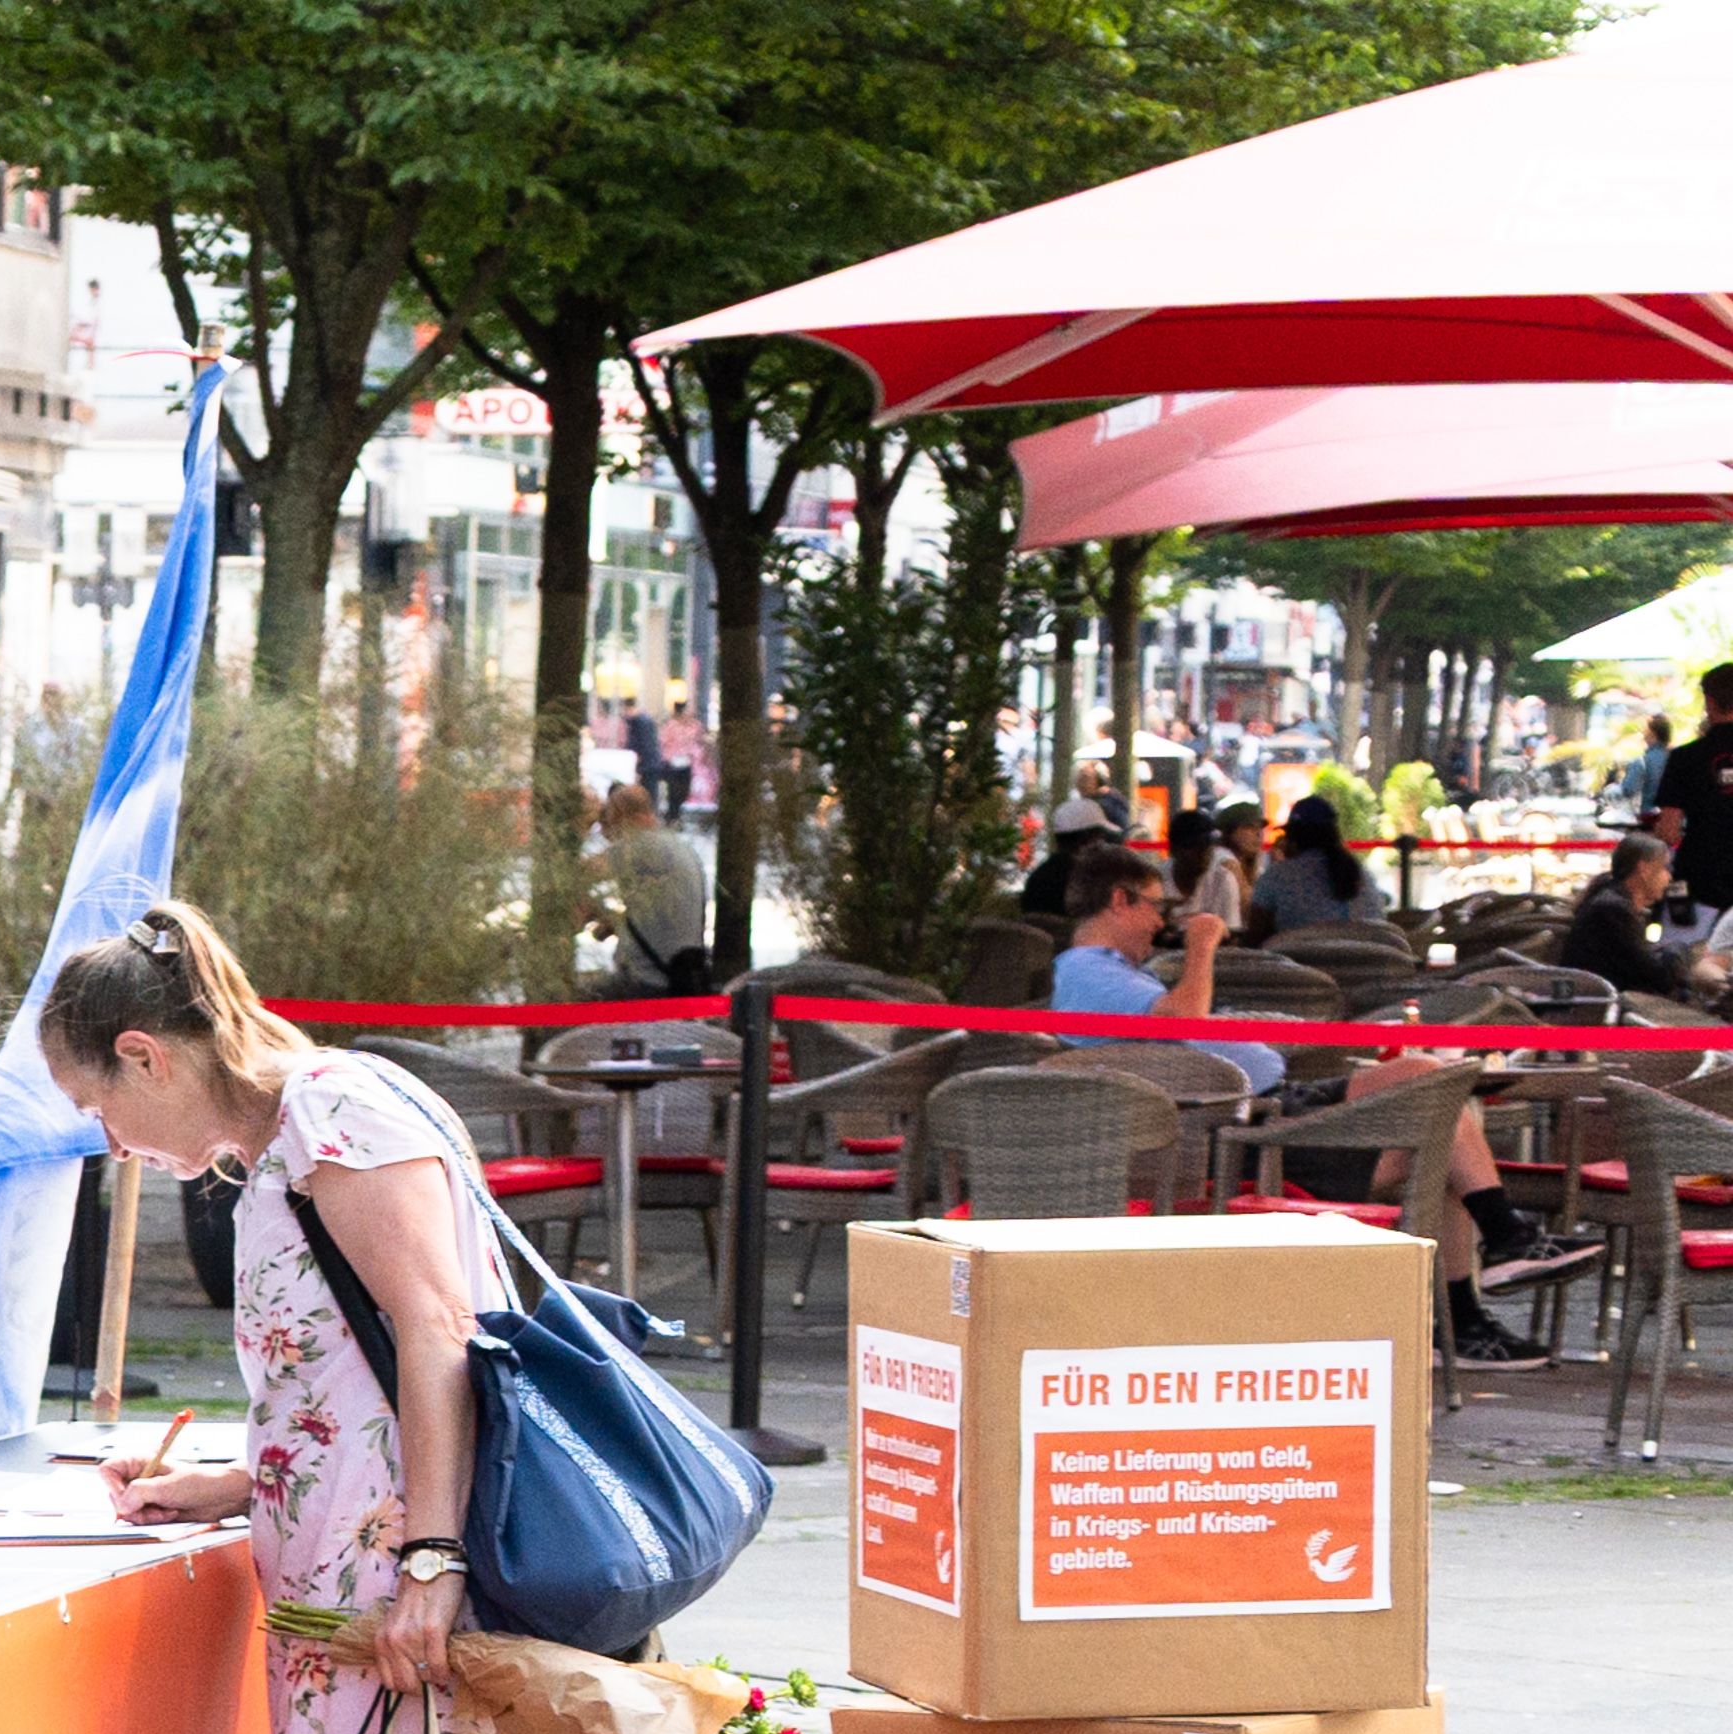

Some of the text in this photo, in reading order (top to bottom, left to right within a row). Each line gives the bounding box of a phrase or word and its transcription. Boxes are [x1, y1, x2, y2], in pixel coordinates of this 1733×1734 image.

[1041, 1365, 1370, 1408] FÜR DEN FRIEDEN
[1051, 1445, 1313, 1476] Keine Lieferung von Geld,
[1051, 1477, 1338, 1507] Waffen und Rüstungsgütern
[1050, 1510, 1277, 1541] in Kriegs- und Krisen-
[1049, 1547, 1133, 1575] gebiete.
